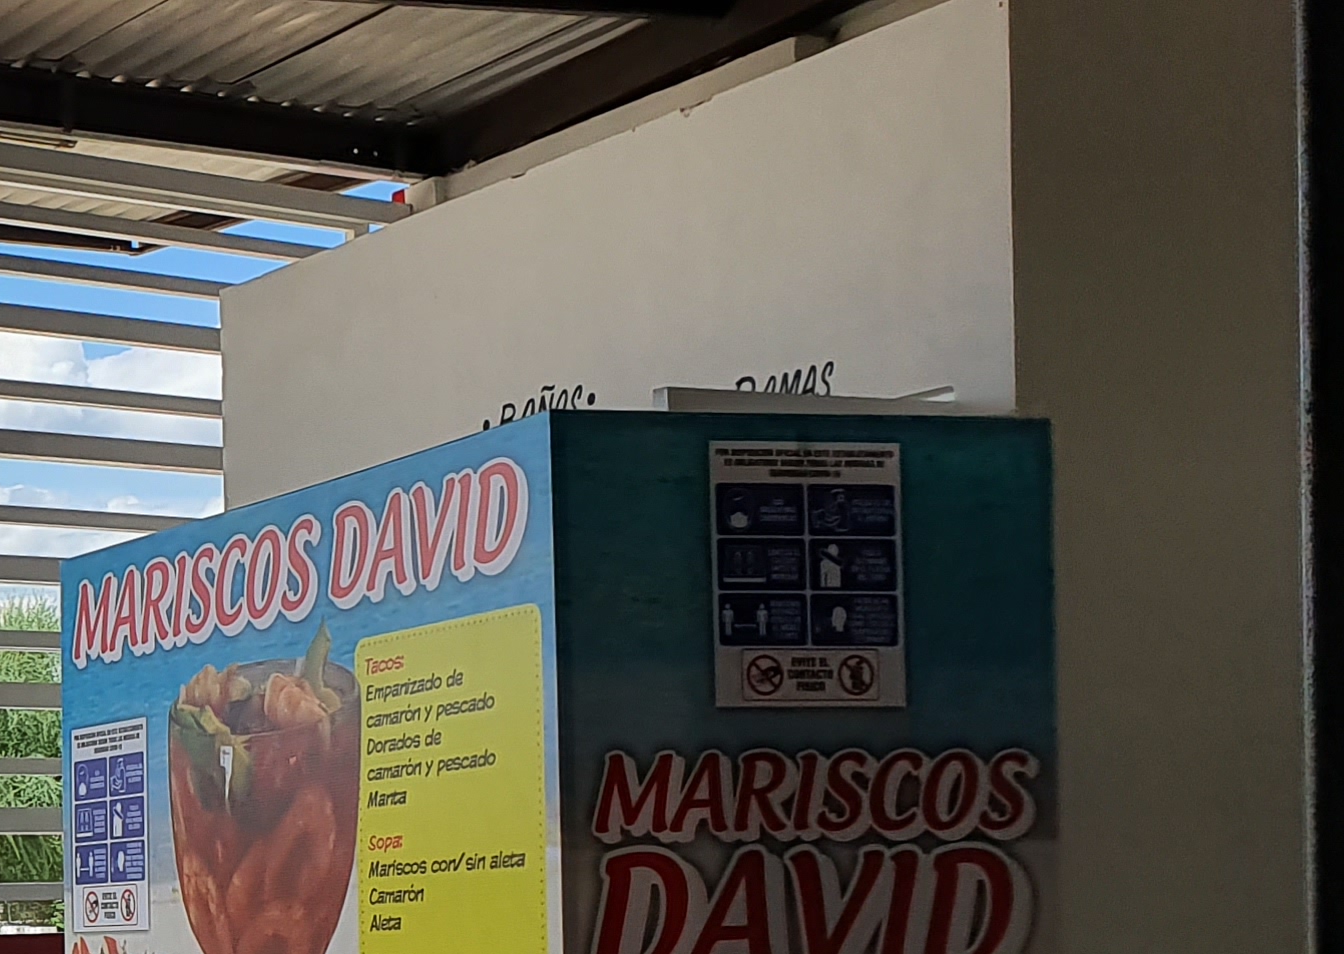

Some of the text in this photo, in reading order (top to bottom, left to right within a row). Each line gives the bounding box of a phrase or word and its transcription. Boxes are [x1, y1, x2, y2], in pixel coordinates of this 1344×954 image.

[73, 457, 528, 668] MARISCOS DAVID
[365, 656, 404, 675] Tacos:
[366, 669, 463, 702] Empanizado de
[367, 692, 495, 728] camarón y pescado
[367, 729, 441, 755] Dorados de
[367, 749, 496, 781] camarón y pescado
[367, 791, 407, 808] Manta
[592, 748, 1039, 843] MARISCOS
[368, 835, 403, 853] Sopa:
[369, 860, 427, 878] Mariscos
[466, 854, 485, 871] sin
[490, 851, 525, 869] aleta
[370, 884, 424, 904] Camarón
[370, 915, 401, 932] Aleta
